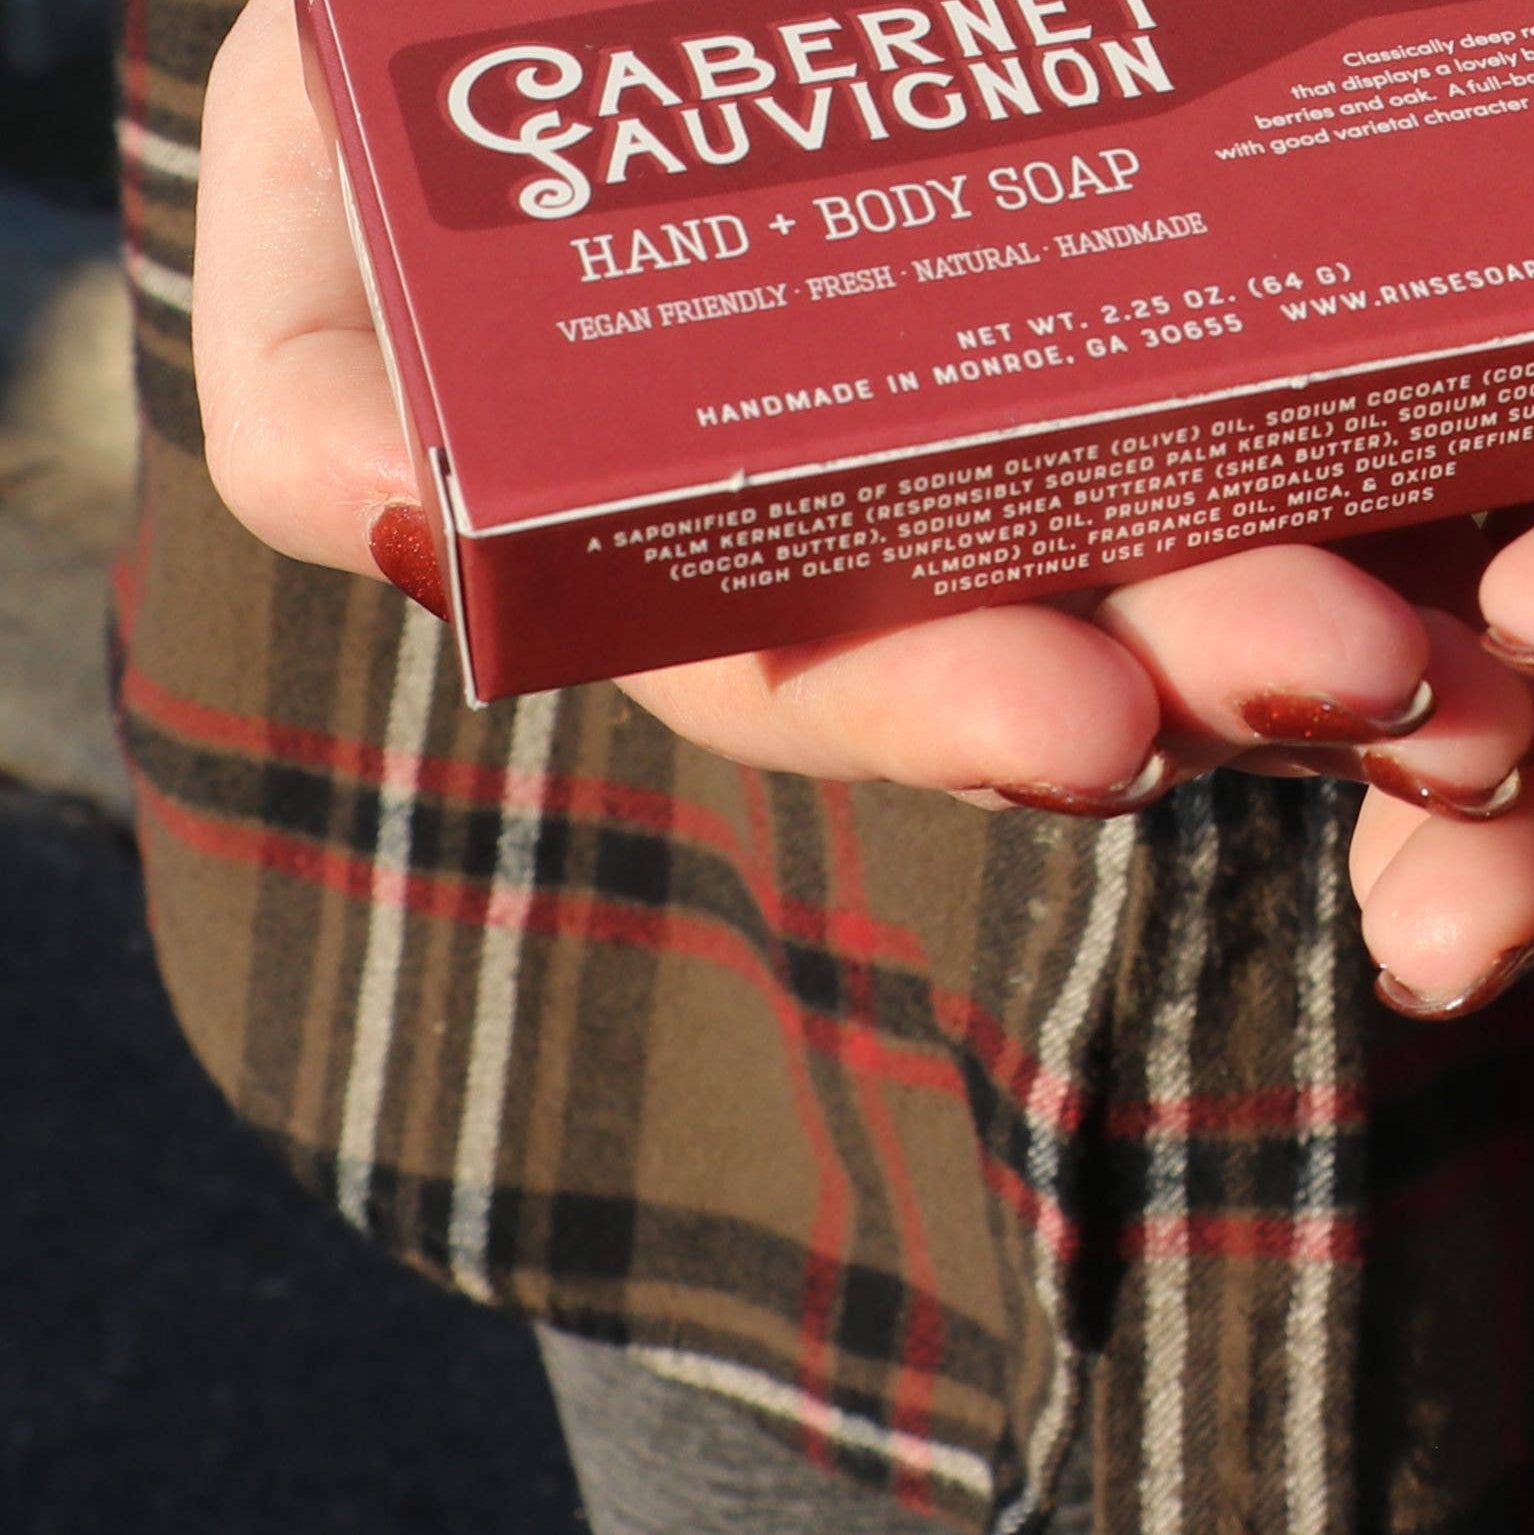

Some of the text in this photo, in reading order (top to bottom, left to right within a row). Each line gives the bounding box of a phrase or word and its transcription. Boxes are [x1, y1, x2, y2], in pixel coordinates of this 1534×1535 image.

[1254, 107, 1335, 129] berries
[1339, 95, 1384, 115] and
[1389, 88, 1438, 107] oak.
[1449, 83, 1466, 97] A
[1291, 81, 1336, 99] that
[1342, 67, 1431, 90] displays
[1435, 64, 1452, 75] a
[1453, 51, 1517, 72] lovely
[1342, 39, 1454, 67] Classically
[1460, 31, 1516, 48] deep
[519, 36, 1175, 220] SAUVIGNON
[1215, 140, 1266, 160] with
[1270, 128, 1330, 154] good
[1333, 113, 1419, 140] varietal
[1424, 98, 1529, 125] character
[570, 148, 1139, 282] HAND BODY SOAP
[556, 213, 1208, 342] VEGAN FRIENDLY FRESH NATURAL HANDMADE
[956, 262, 1351, 349] NET WT. 2.25 OZ. (64 G)
[696, 379, 874, 427] HANDMADE
[886, 371, 919, 394] IN
[1086, 335, 1128, 357] GA
[1140, 314, 1242, 348] 30655
[587, 538, 602, 552] A
[614, 509, 756, 546] SAPONIFIED
[770, 492, 845, 518] BLEND
[858, 484, 887, 502] OF
[899, 464, 993, 494] SODIUM
[1005, 445, 1098, 475] OLIVATE
[1111, 425, 1200, 456] (OLIVE)
[1266, 396, 1356, 426] SODIUM
[1367, 374, 1471, 407] COCOATE
[645, 538, 708, 563] PALM
[720, 512, 853, 549] KERNELATE
[865, 479, 1033, 524] (RESPONSIBLY
[1046, 456, 1154, 489] SOURCED
[1166, 442, 1226, 466] PALM
[1238, 421, 1334, 453] KERNEL)
[1398, 392, 1487, 422] SODIUM
[670, 551, 764, 581] (COCOA
[898, 508, 991, 538] SODIUM
[1003, 496, 1062, 518] SHEA
[1074, 468, 1203, 505] BUTTERATE
[1215, 453, 1284, 479] (SHEA
[1410, 412, 1498, 441] SODIUM
[720, 567, 790, 593] (HIGH
[803, 553, 870, 577] OLEIC
[883, 520, 1038, 562] SUNFLOWER)
[1105, 491, 1195, 520] PRUNUS
[1206, 462, 1344, 501] AMYGDALUS
[1355, 445, 1436, 473] DULCIS
[912, 461, 1456, 579] ALMOND) FRAGRANCE OXIDE
[934, 487, 1434, 595] DISCONTINUE USE IF DISCOMFORT OCCURS
